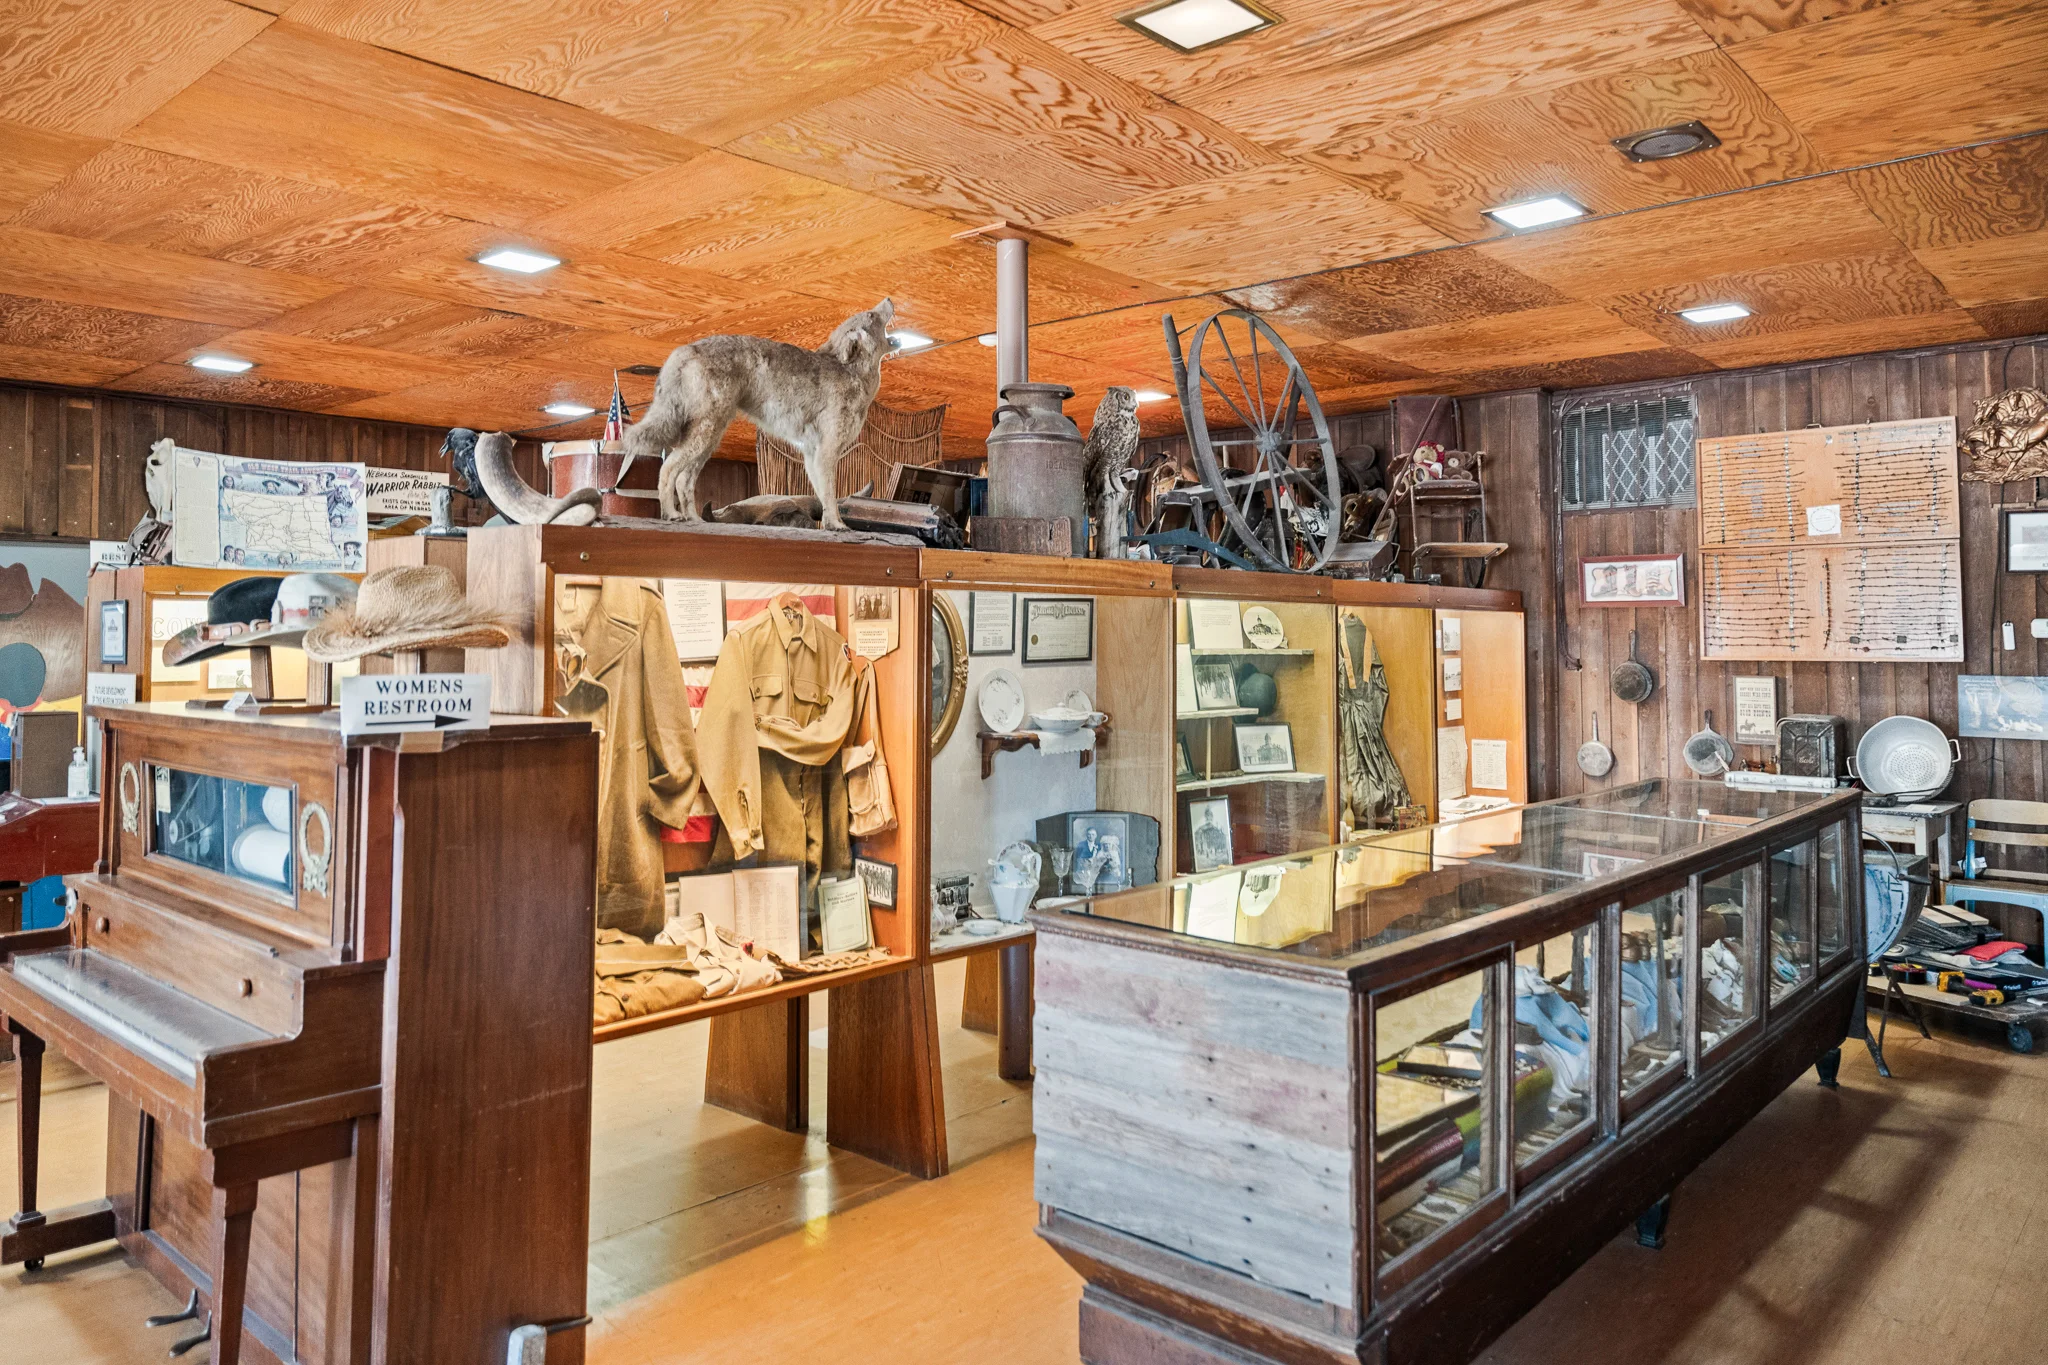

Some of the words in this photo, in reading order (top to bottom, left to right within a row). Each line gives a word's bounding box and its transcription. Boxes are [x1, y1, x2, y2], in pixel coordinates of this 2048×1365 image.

[366, 481, 410, 498] WARRIOR
[412, 479, 442, 489] RABBIT
[102, 552, 127, 561] REST
[376, 679, 463, 695] WOMENS
[364, 697, 472, 716] RESTROOM
